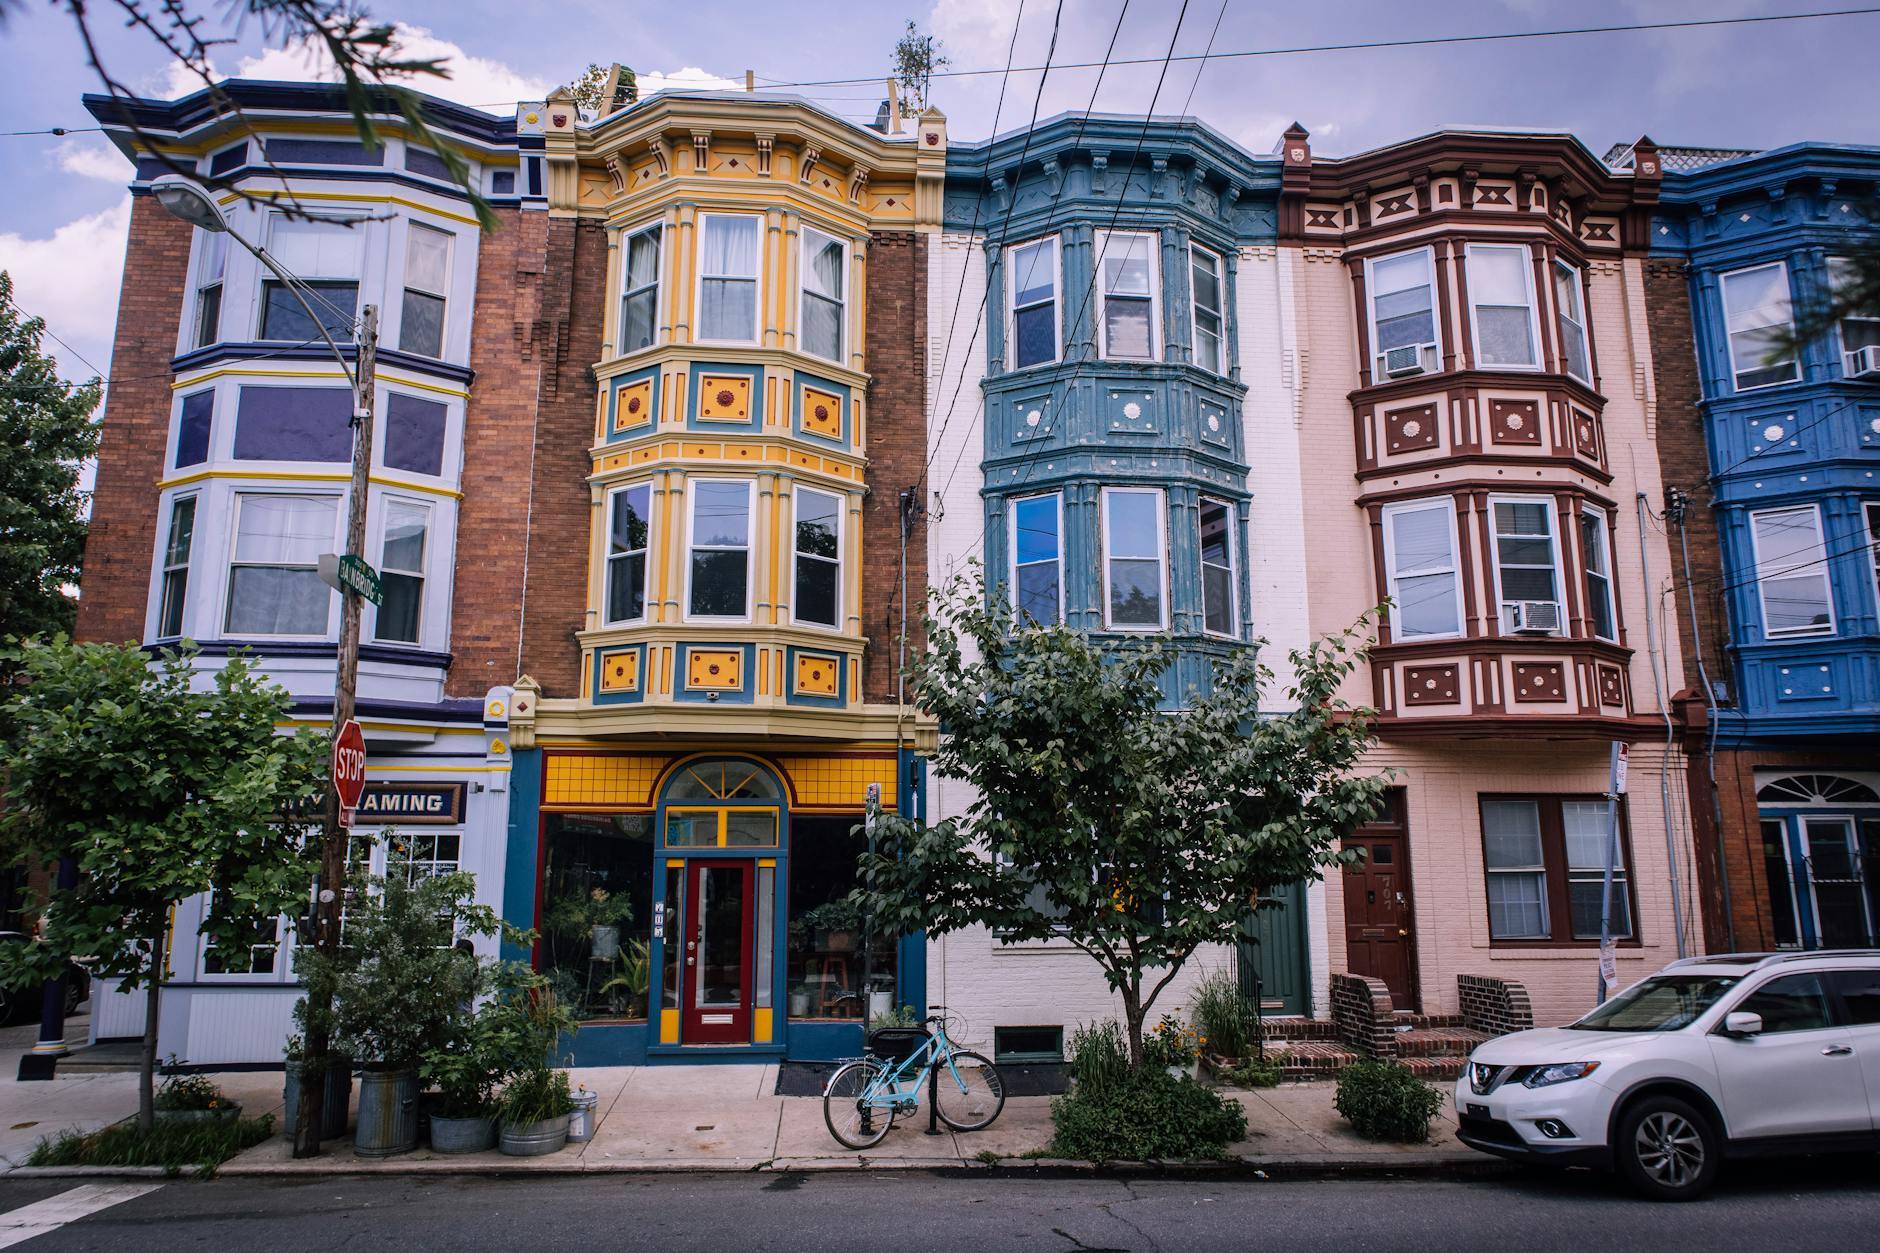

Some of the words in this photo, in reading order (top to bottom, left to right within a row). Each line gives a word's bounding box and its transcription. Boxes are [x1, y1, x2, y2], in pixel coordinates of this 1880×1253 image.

[338, 747, 364, 781] STOP
[356, 794, 443, 811] AMING
[1382, 877, 1391, 910] 707
